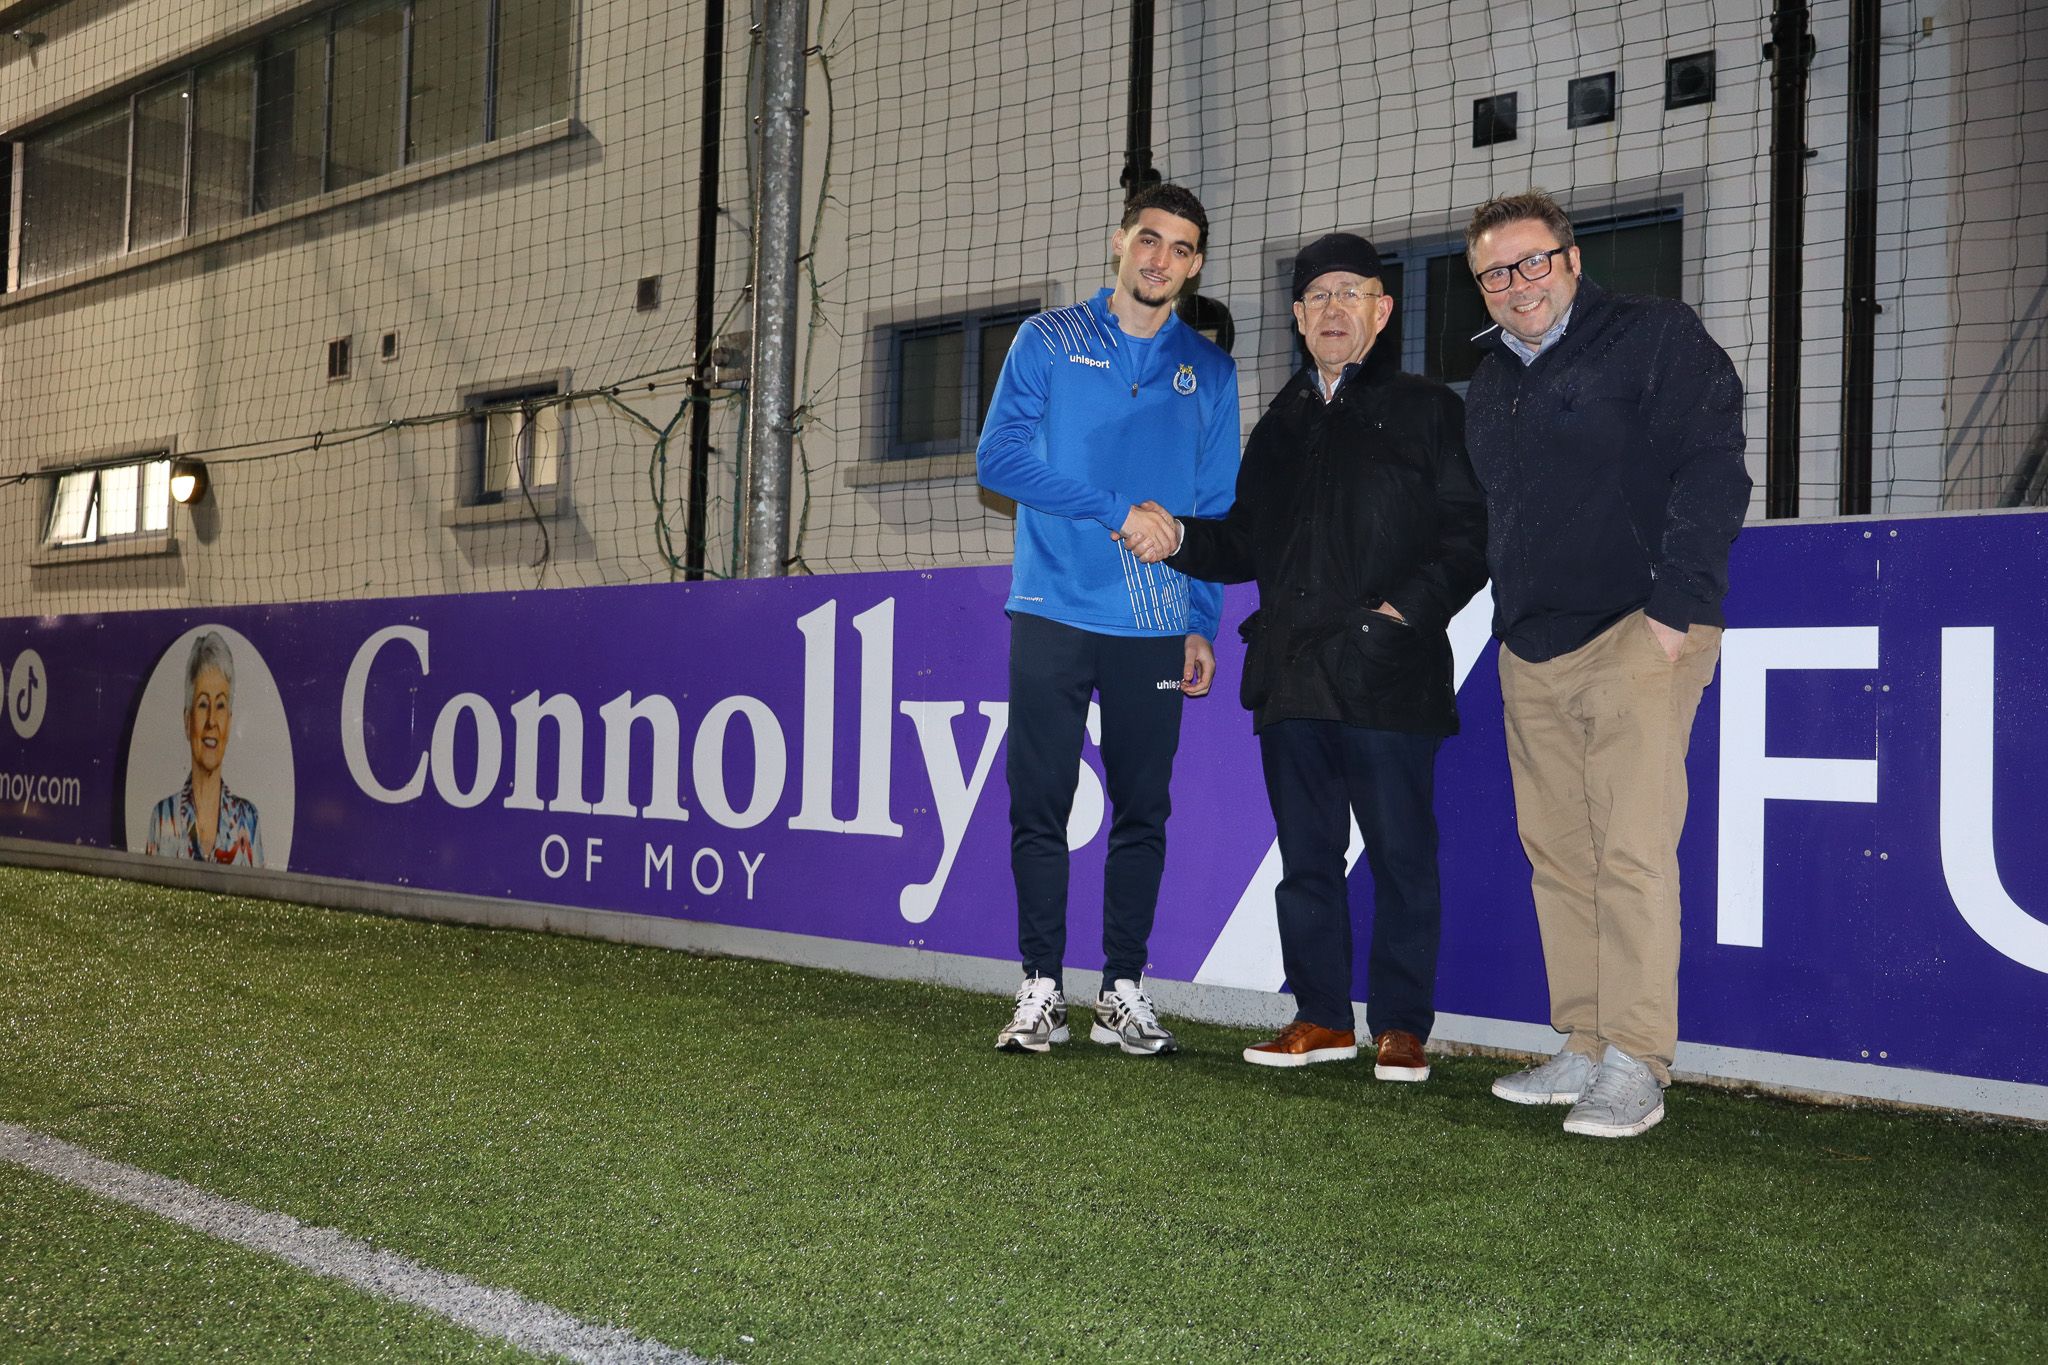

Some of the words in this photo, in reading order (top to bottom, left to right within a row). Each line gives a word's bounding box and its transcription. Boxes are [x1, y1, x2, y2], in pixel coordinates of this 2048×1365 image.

[1070, 354, 1110, 369] uhlsport
[540, 834, 603, 882] OF
[644, 842, 766, 900] MOY
